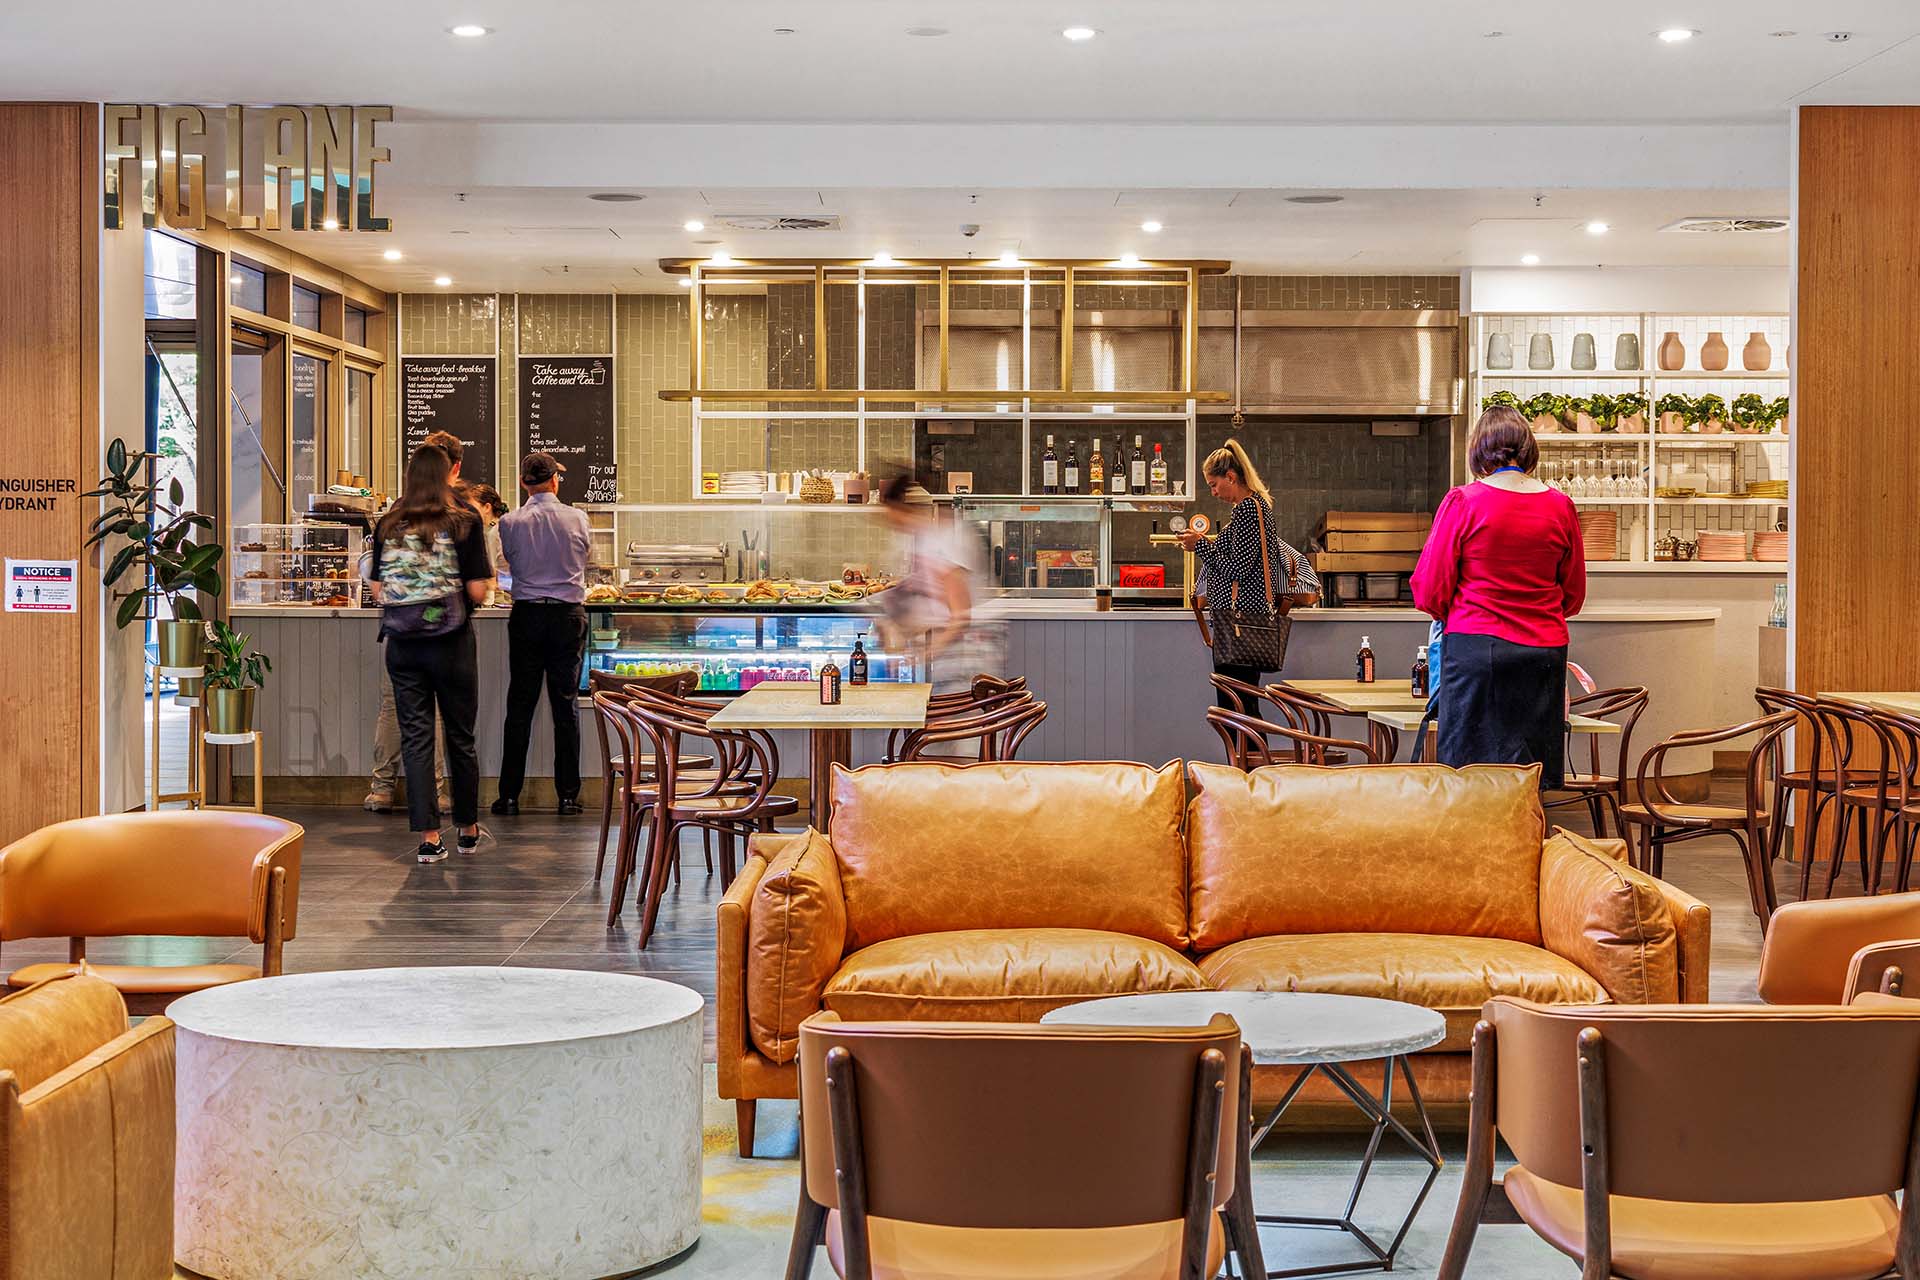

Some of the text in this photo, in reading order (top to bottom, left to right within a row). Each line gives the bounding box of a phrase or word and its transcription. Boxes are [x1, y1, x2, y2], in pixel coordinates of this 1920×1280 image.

[104, 103, 393, 232] FIG LANE
[404, 364, 422, 373] Take
[423, 366, 440, 375] away
[441, 363, 455, 373] food
[532, 363, 589, 376] Take away
[531, 374, 594, 385] Coffee and Tea
[23, 567, 61, 576] NOTICE
